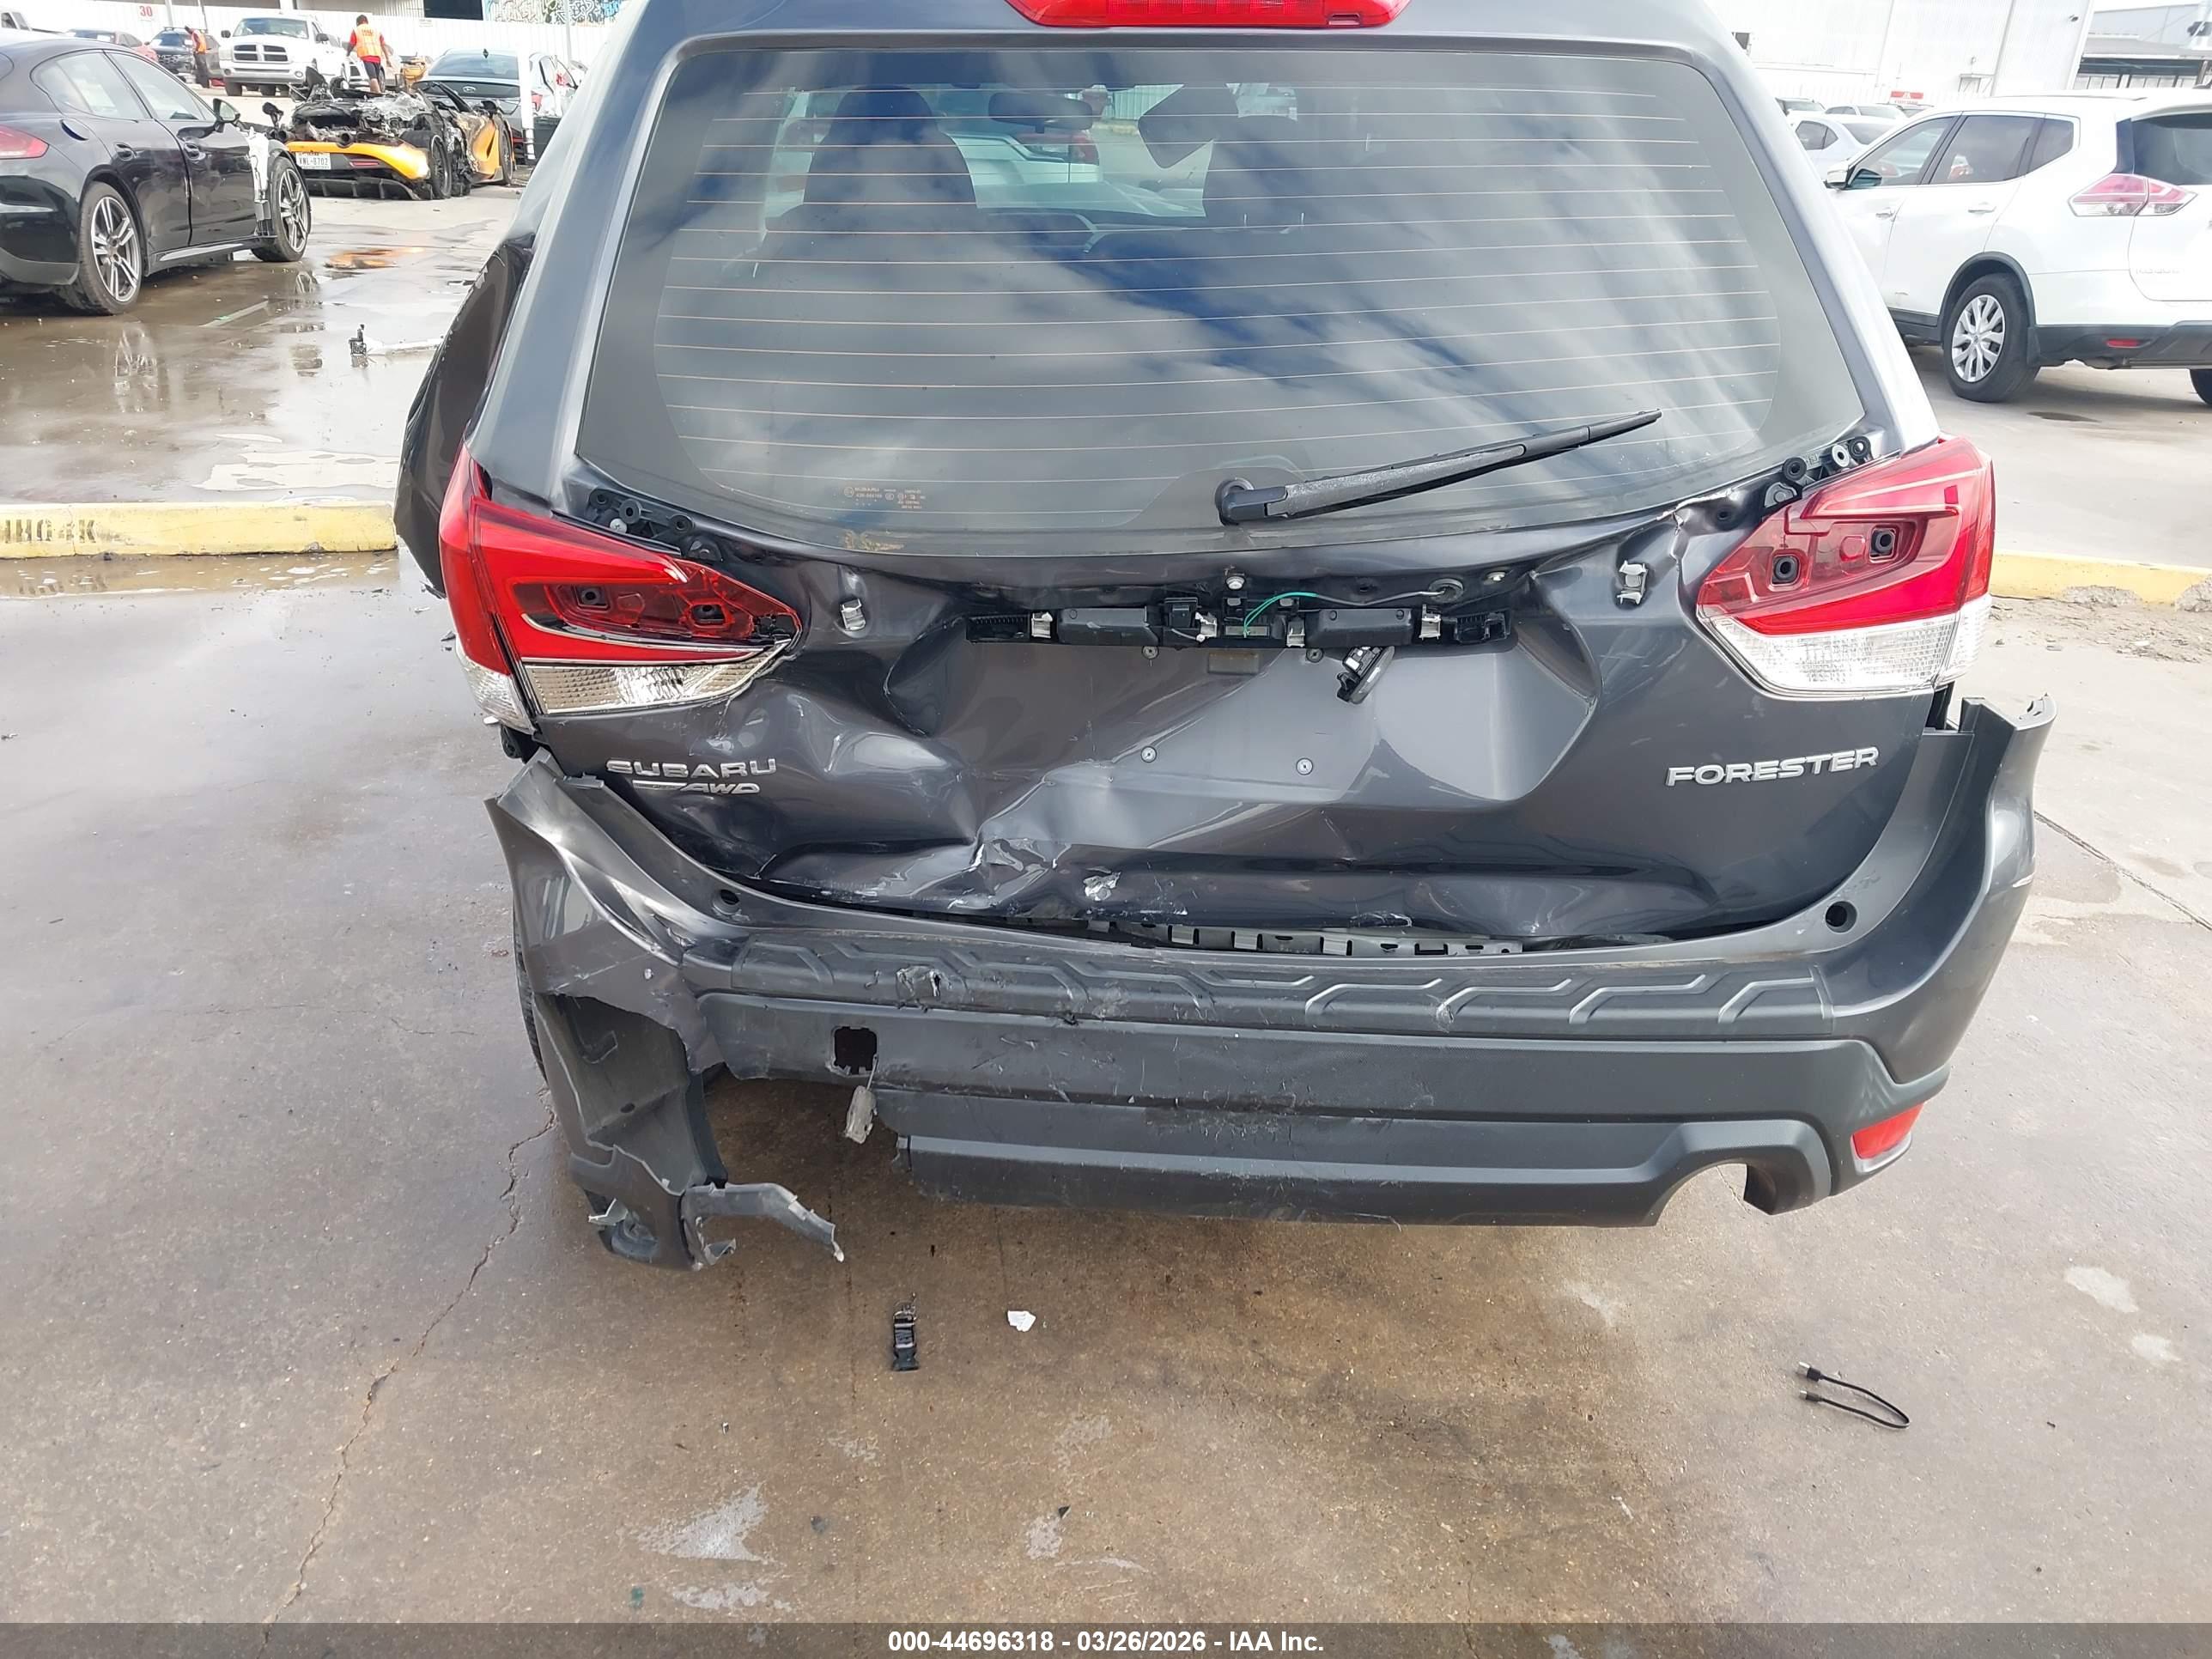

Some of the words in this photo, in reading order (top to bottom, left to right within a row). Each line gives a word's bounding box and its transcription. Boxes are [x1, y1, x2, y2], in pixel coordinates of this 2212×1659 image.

[139, 5, 153, 16] 30
[606, 758, 776, 779] SUBARU
[1666, 746, 1880, 787] FORESTER
[680, 781, 760, 794] AWD
